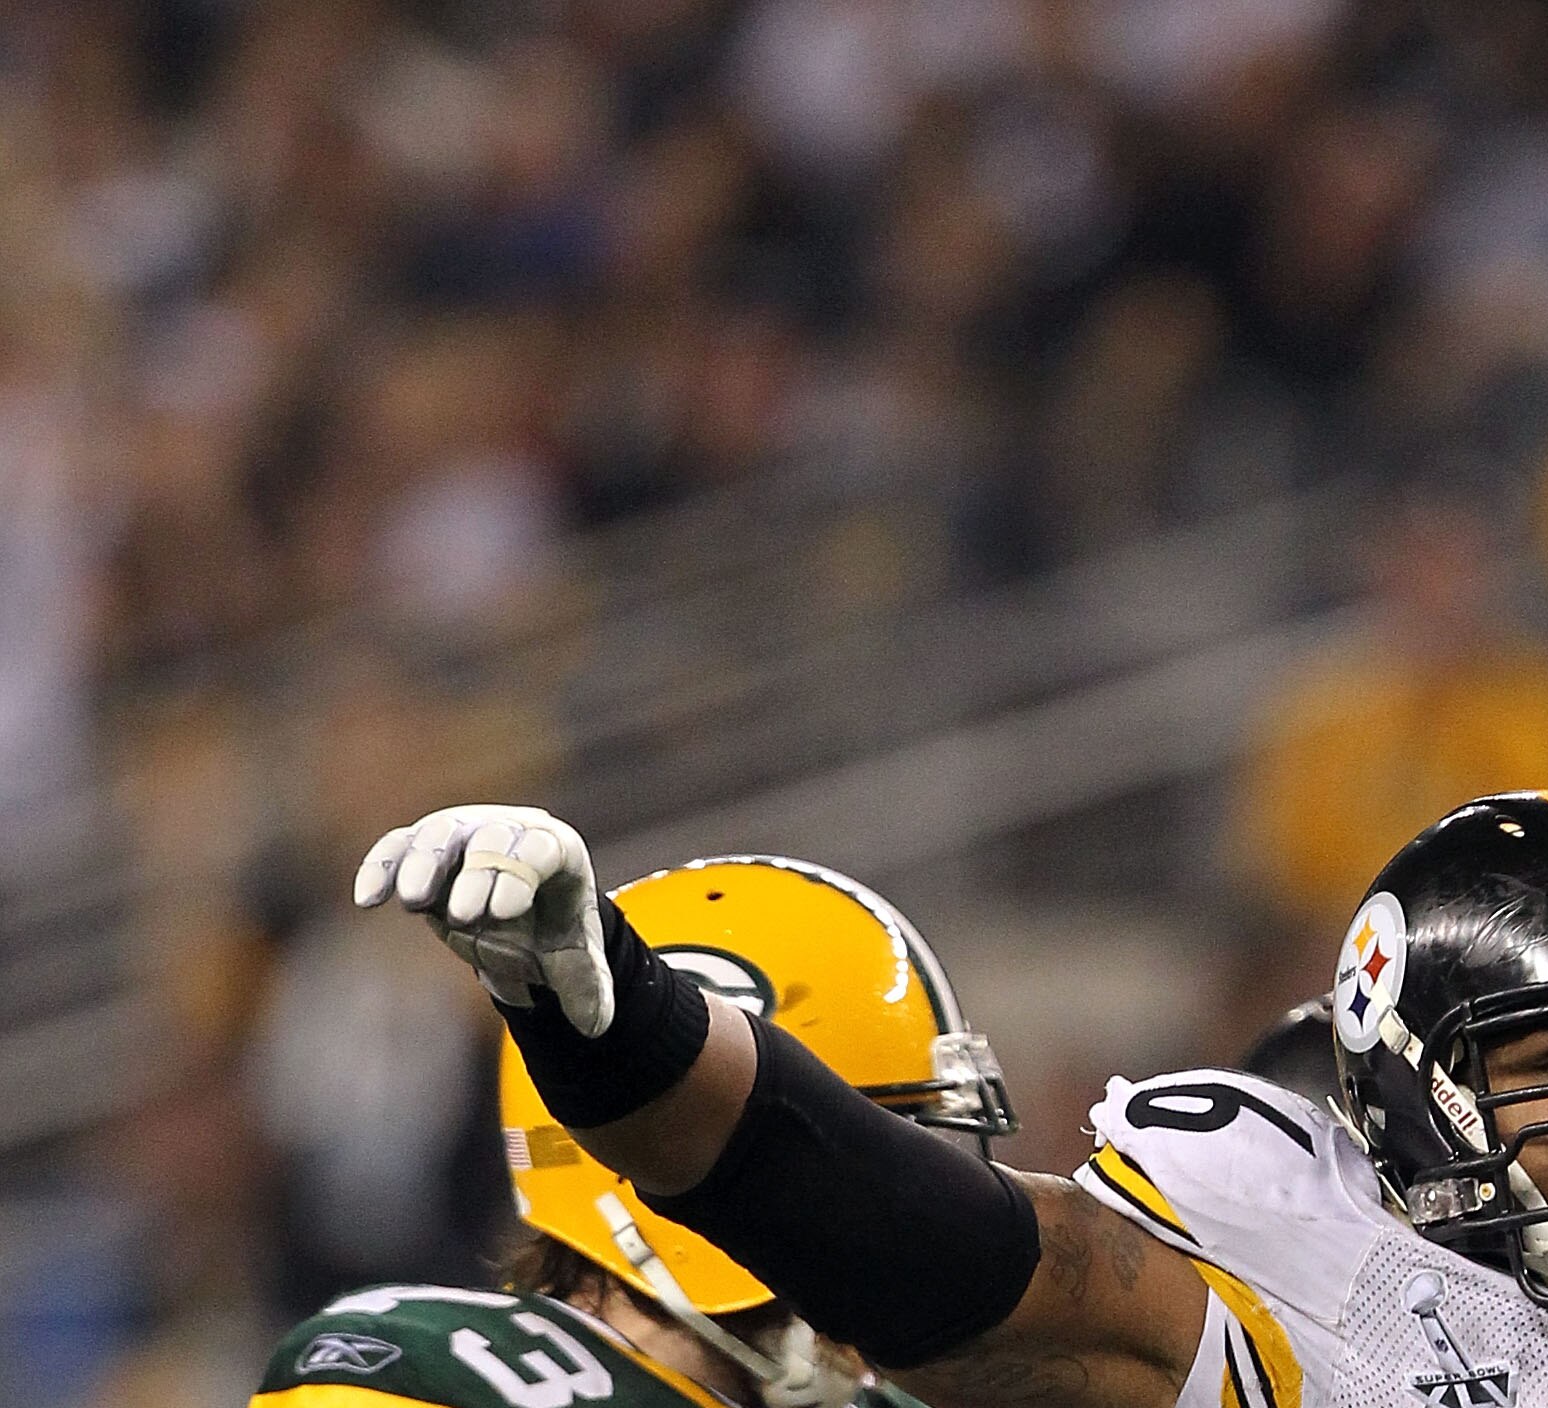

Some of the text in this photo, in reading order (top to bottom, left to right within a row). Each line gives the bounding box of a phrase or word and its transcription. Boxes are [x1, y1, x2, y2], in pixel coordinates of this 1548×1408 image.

[1431, 1077, 1478, 1131] ddell
[1415, 1365, 1504, 1385] SUPER BOWL
